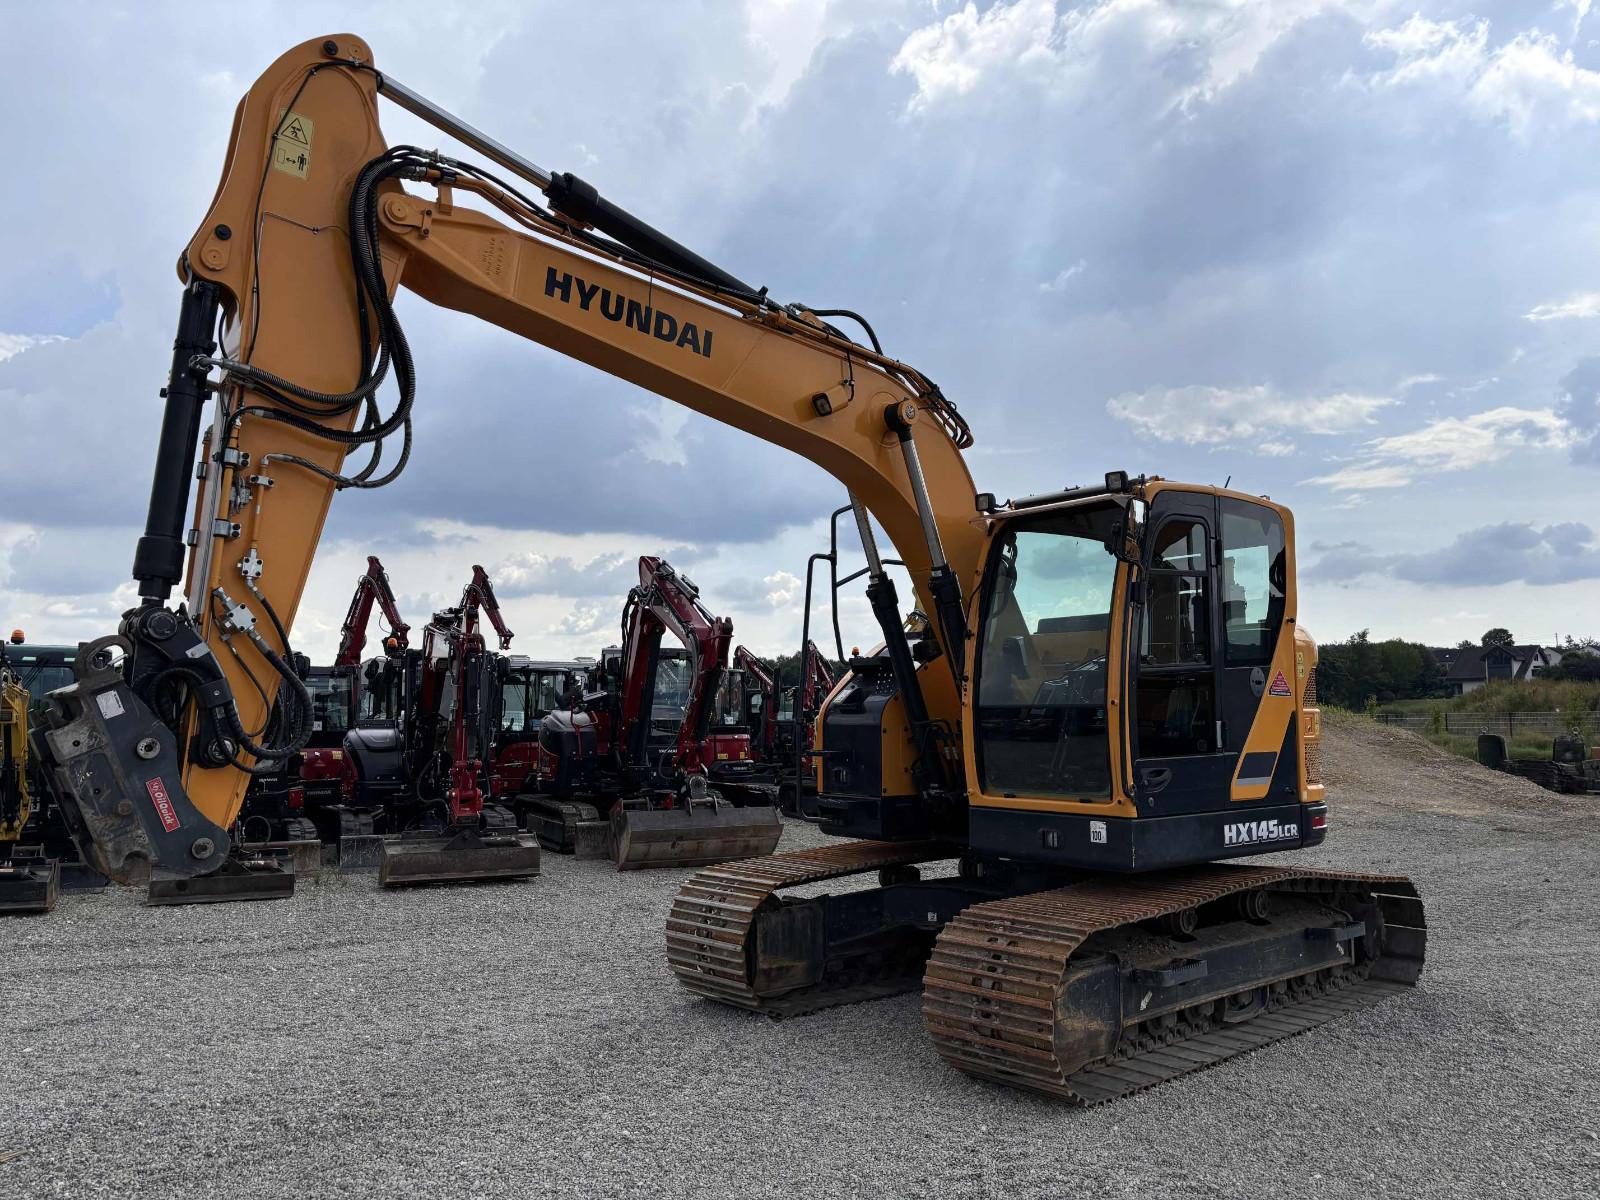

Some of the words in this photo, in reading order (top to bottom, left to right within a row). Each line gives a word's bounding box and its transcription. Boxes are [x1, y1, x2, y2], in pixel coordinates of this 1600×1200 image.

[544, 266, 713, 359] HYUNDAI
[153, 791, 175, 825] OilQuick
[1223, 820, 1298, 844] HX145LCR
